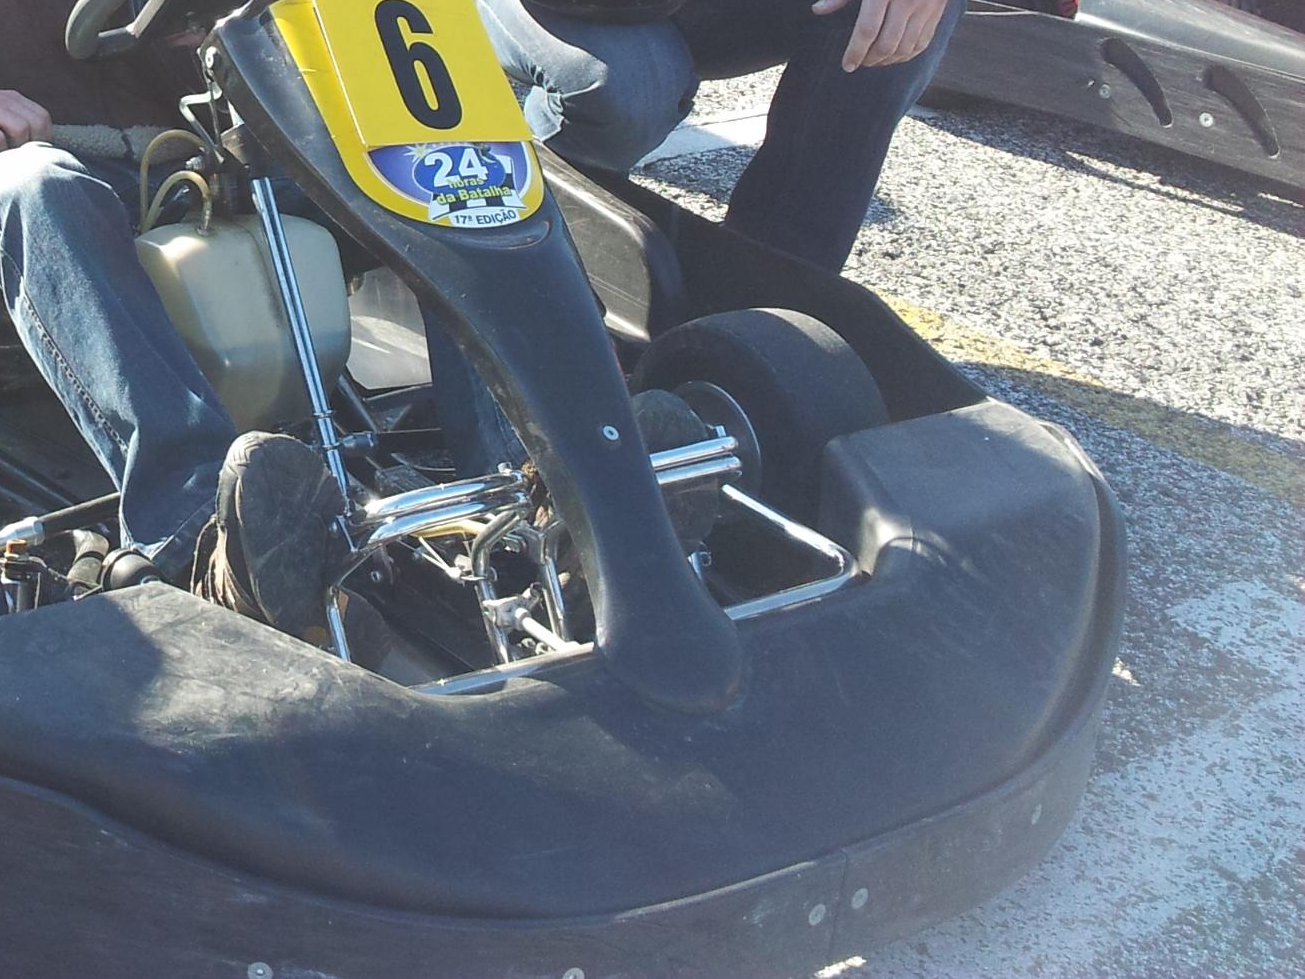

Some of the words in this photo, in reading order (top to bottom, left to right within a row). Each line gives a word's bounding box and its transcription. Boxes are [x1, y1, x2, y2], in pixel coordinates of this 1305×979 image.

[424, 148, 489, 188] 24
[436, 192, 457, 205] da
[458, 185, 512, 201] Batalha
[475, 209, 517, 225] EDIÇÃO
